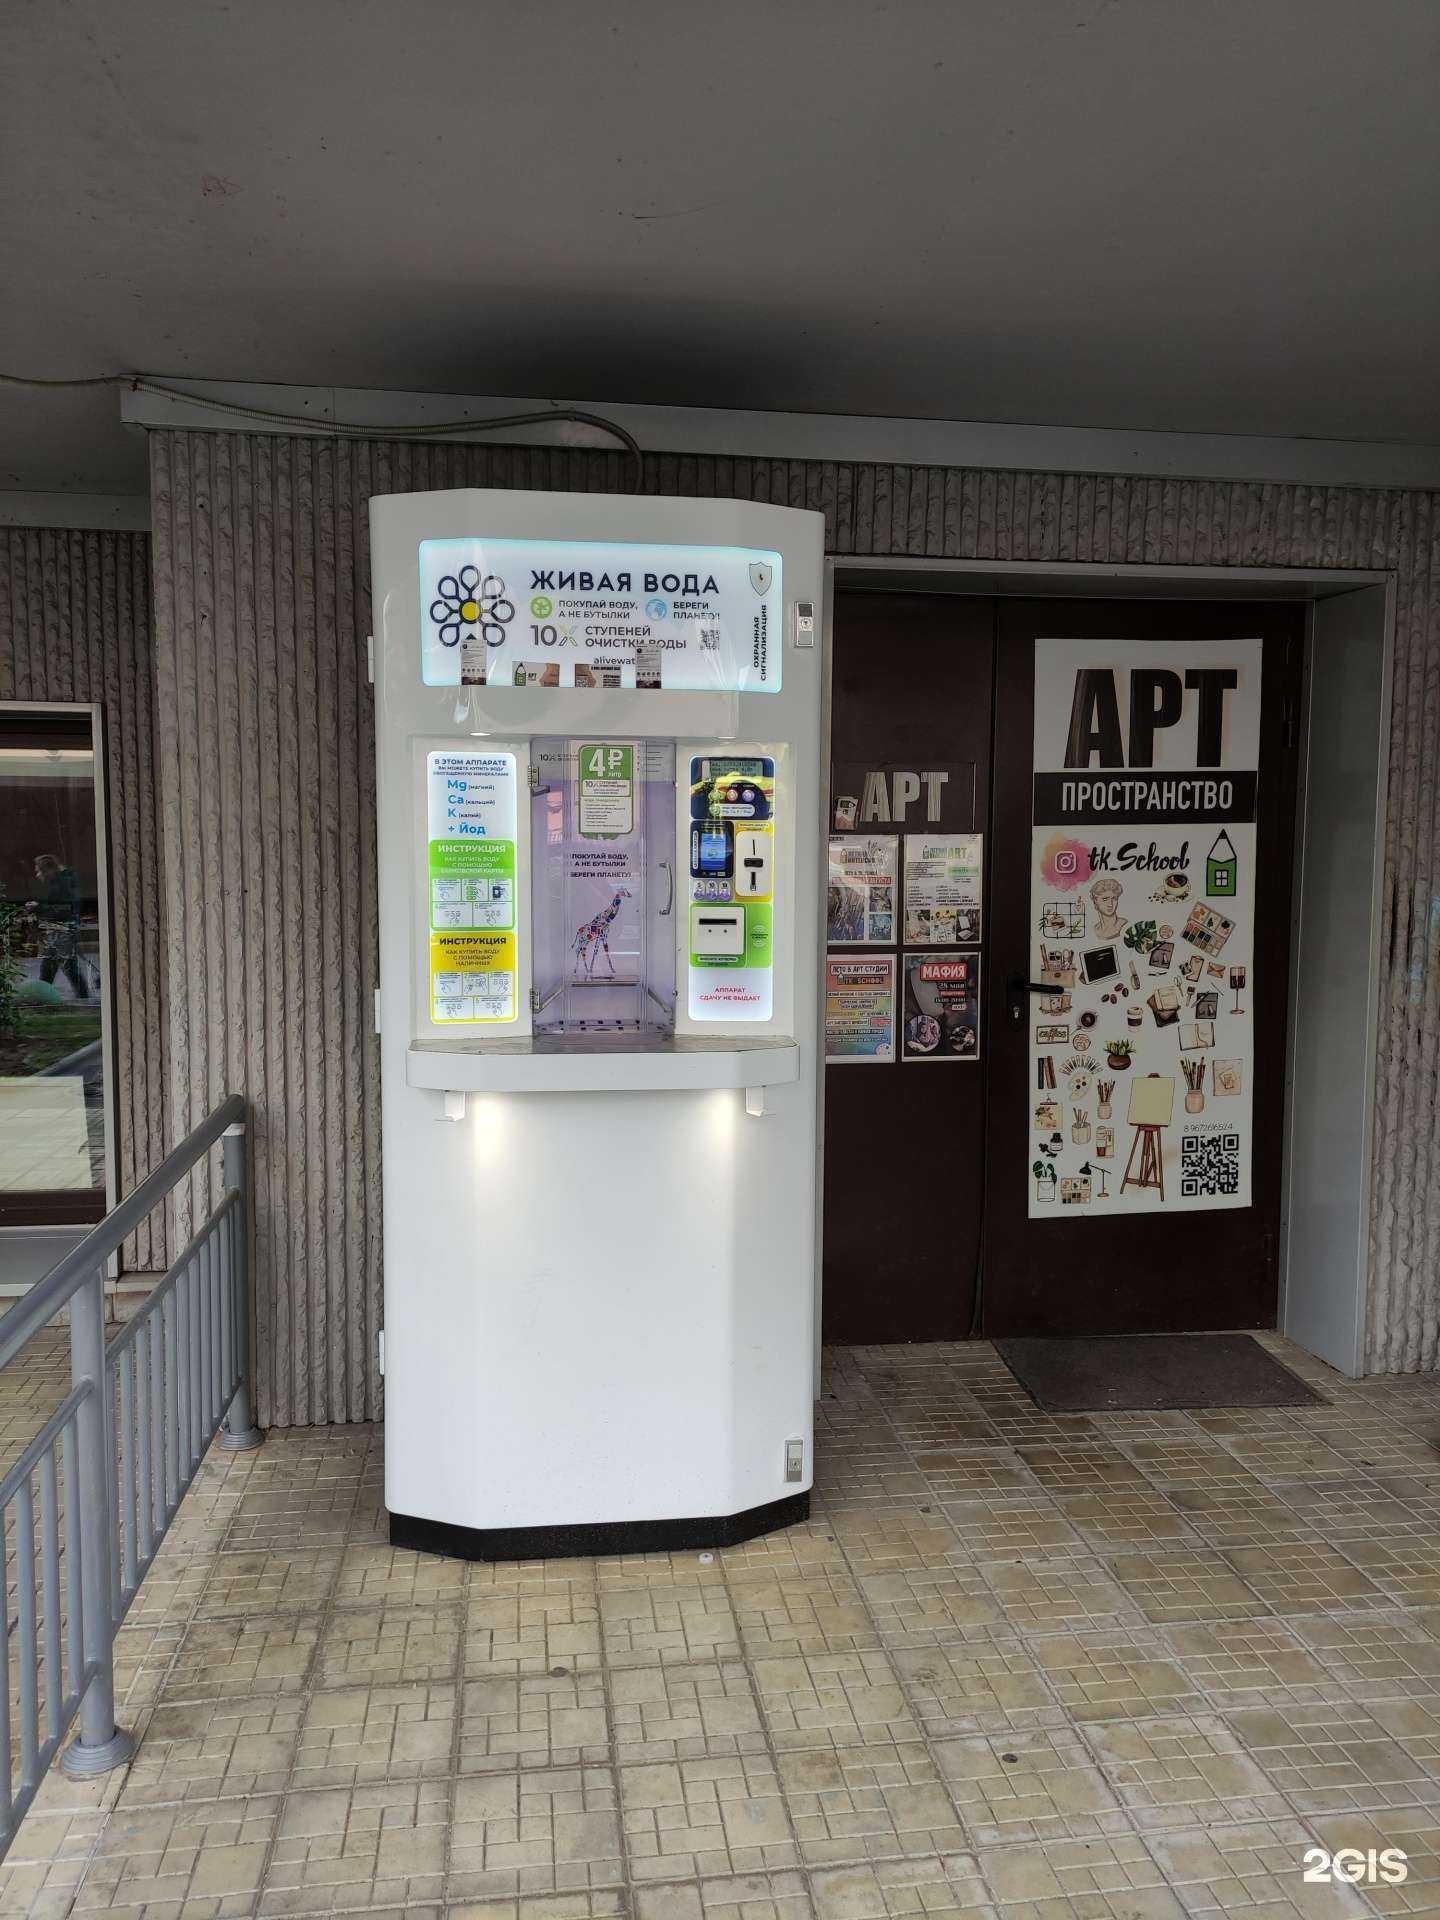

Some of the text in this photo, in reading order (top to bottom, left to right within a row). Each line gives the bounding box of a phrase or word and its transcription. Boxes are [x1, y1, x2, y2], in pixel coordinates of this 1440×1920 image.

[530, 570, 720, 596] ЖИВАЯ ВОДА
[558, 599, 638, 610] ПОКУПАЙ ВОДУ,
[673, 601, 709, 610] БЕРЕГИ
[583, 611, 630, 619] БУТЫЛКИ
[585, 625, 651, 636] СТУПЕНЕЙ
[585, 638, 645, 648] ОЧИСТКИ
[593, 656, 636, 665] alivewat
[1063, 667, 1238, 769] АРТ
[447, 779, 467, 792] Mg
[447, 794, 465, 805] Ca
[861, 771, 949, 822] АРТ
[1060, 779, 1234, 812] ПРОСТРАНСТВО
[459, 822, 486, 835] Йод
[438, 844, 506, 854] ИНСТРУКЦИЯ
[571, 852, 607, 860] ПОКУПАЙ
[1088, 841, 1190, 872] tk_School
[439, 937, 507, 946] ИНСТРУКЦИЯ
[922, 965, 965, 978] МАФИЯ
